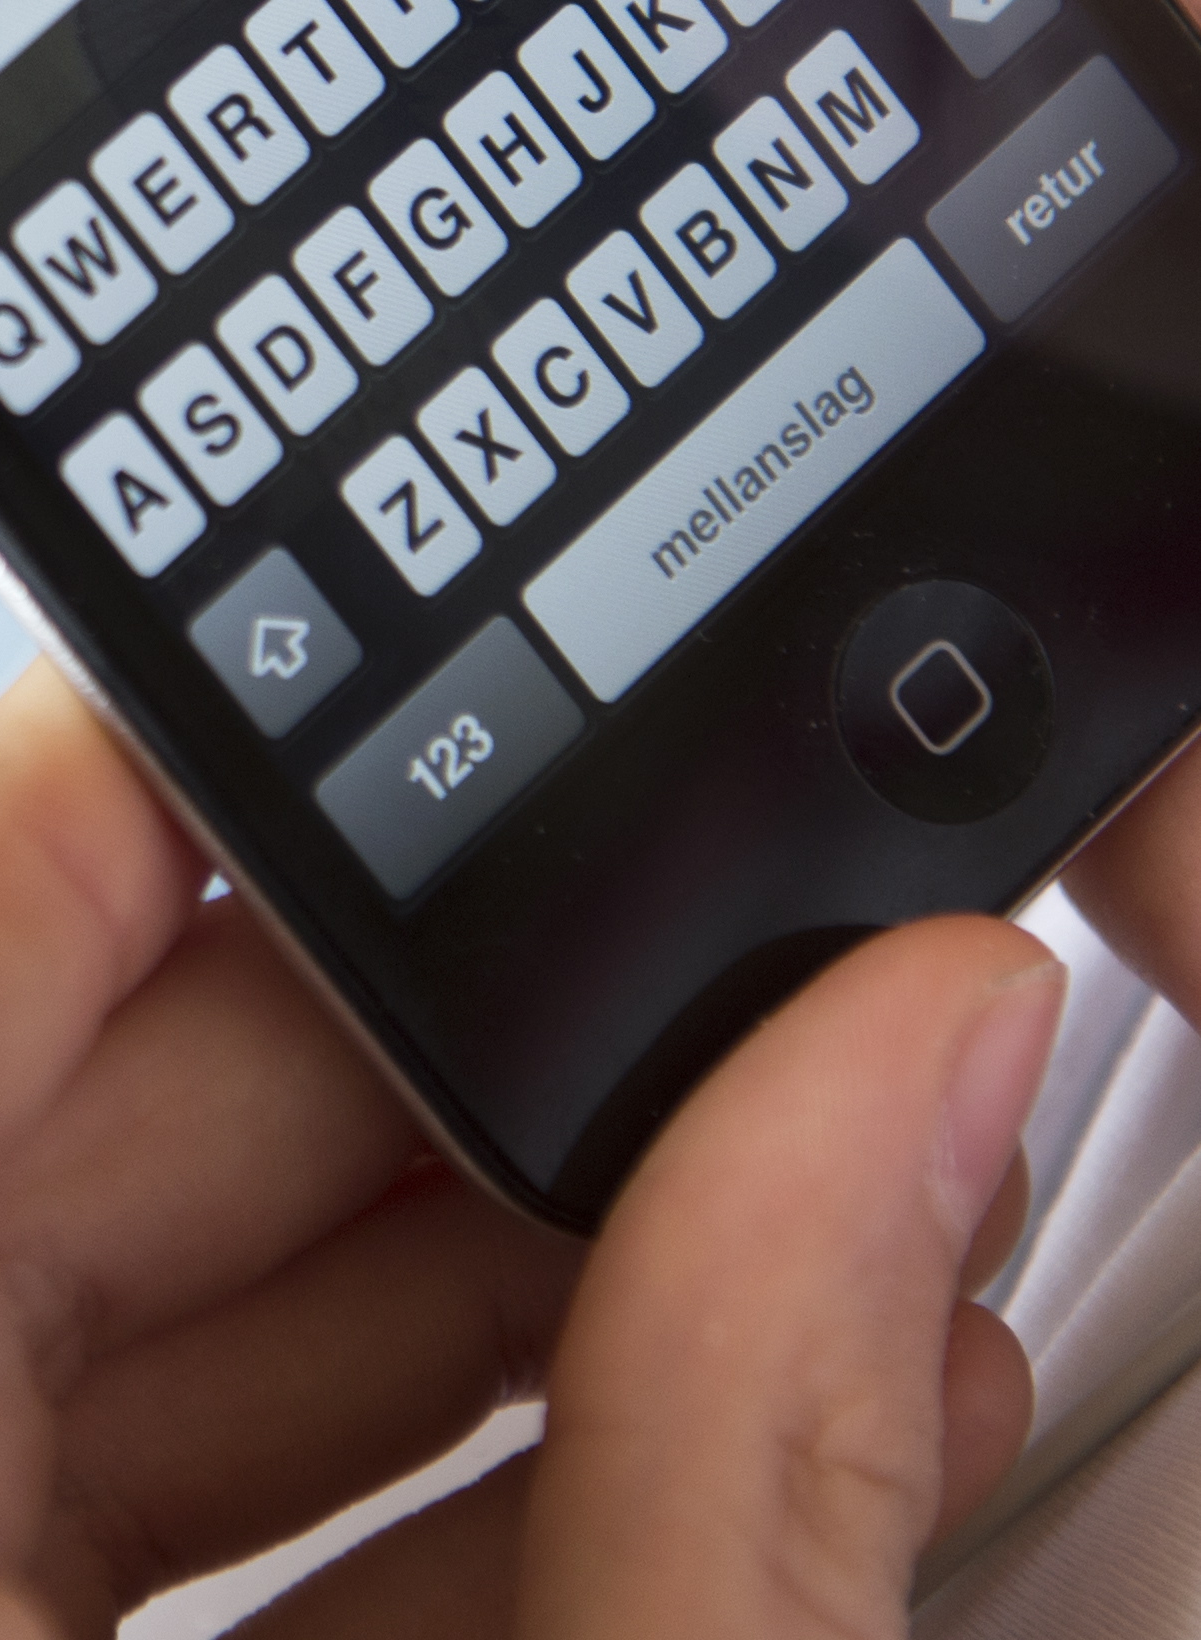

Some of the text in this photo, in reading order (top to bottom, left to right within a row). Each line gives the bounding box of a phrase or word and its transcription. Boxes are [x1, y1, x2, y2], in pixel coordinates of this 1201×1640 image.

[44, 217, 119, 297] W
[132, 156, 198, 228] E
[205, 92, 274, 162] R
[280, 19, 337, 85] T
[1003, 139, 1106, 247] retur
[111, 468, 170, 533] A
[183, 393, 242, 457] S
[253, 324, 316, 393] D
[332, 249, 379, 322] F
[408, 186, 473, 252] G
[478, 111, 548, 188] H
[575, 48, 613, 115] J
[378, 66, 891, 554] Z X C V B N M
[650, 365, 876, 579] mellanslag
[407, 713, 495, 800] 123
